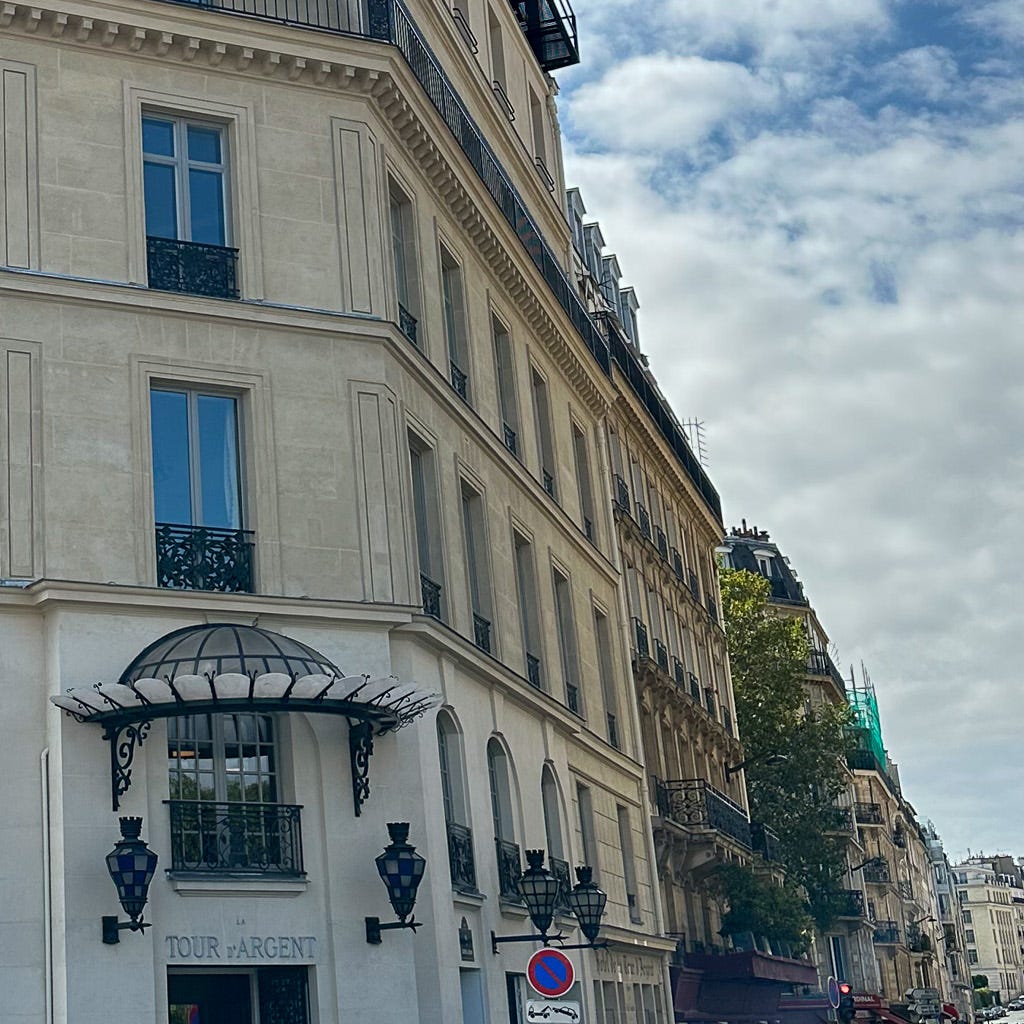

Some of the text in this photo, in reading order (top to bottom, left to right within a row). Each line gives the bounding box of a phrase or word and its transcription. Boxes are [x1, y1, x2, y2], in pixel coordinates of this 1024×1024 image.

[236, 918, 246, 926] LA
[165, 935, 317, 959] TOUR D'ARGENT
